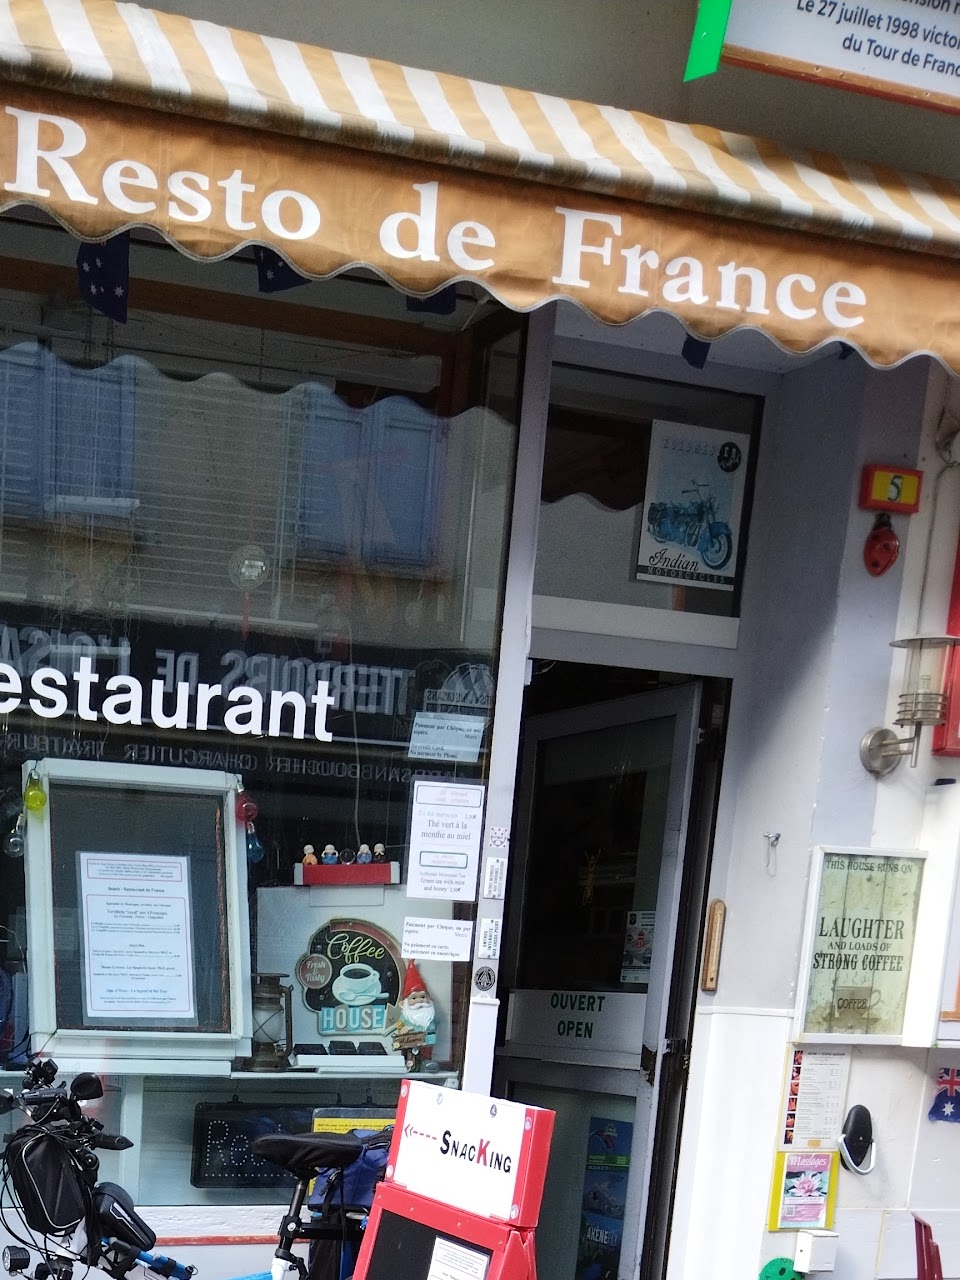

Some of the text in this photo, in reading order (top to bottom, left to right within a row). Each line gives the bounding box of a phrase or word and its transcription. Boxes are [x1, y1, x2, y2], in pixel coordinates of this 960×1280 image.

[797, 0, 814, 13] Le
[817, 0, 836, 18] 27
[836, 4, 883, 30] juillet
[886, 15, 919, 39] 1998
[842, 33, 960, 78] du Tour de Franc
[4, 106, 321, 240] Resto
[379, 181, 496, 271] de
[552, 206, 866, 328] France
[887, 475, 903, 502] 5
[648, 548, 699, 572] Indian
[427, 820, 440, 828] Thé
[421, 830, 445, 839] menthe
[456, 832, 471, 841] miel
[826, 860, 913, 873] THIS HOUSE RUNS ON
[819, 917, 905, 940] LAUGHTER
[325, 933, 386, 964] Coffee
[828, 941, 892, 951] AND LOADS OF
[305, 960, 326, 970] Fresh
[813, 952, 903, 972] STRONG COFFEE
[305, 973, 325, 984] Tasty
[550, 992, 605, 1012] OUVERT
[837, 997, 867, 1010] COFFEE
[322, 1006, 384, 1030] HOUSE
[557, 1020, 594, 1039] OPEN
[790, 1154, 827, 1168] Massages
